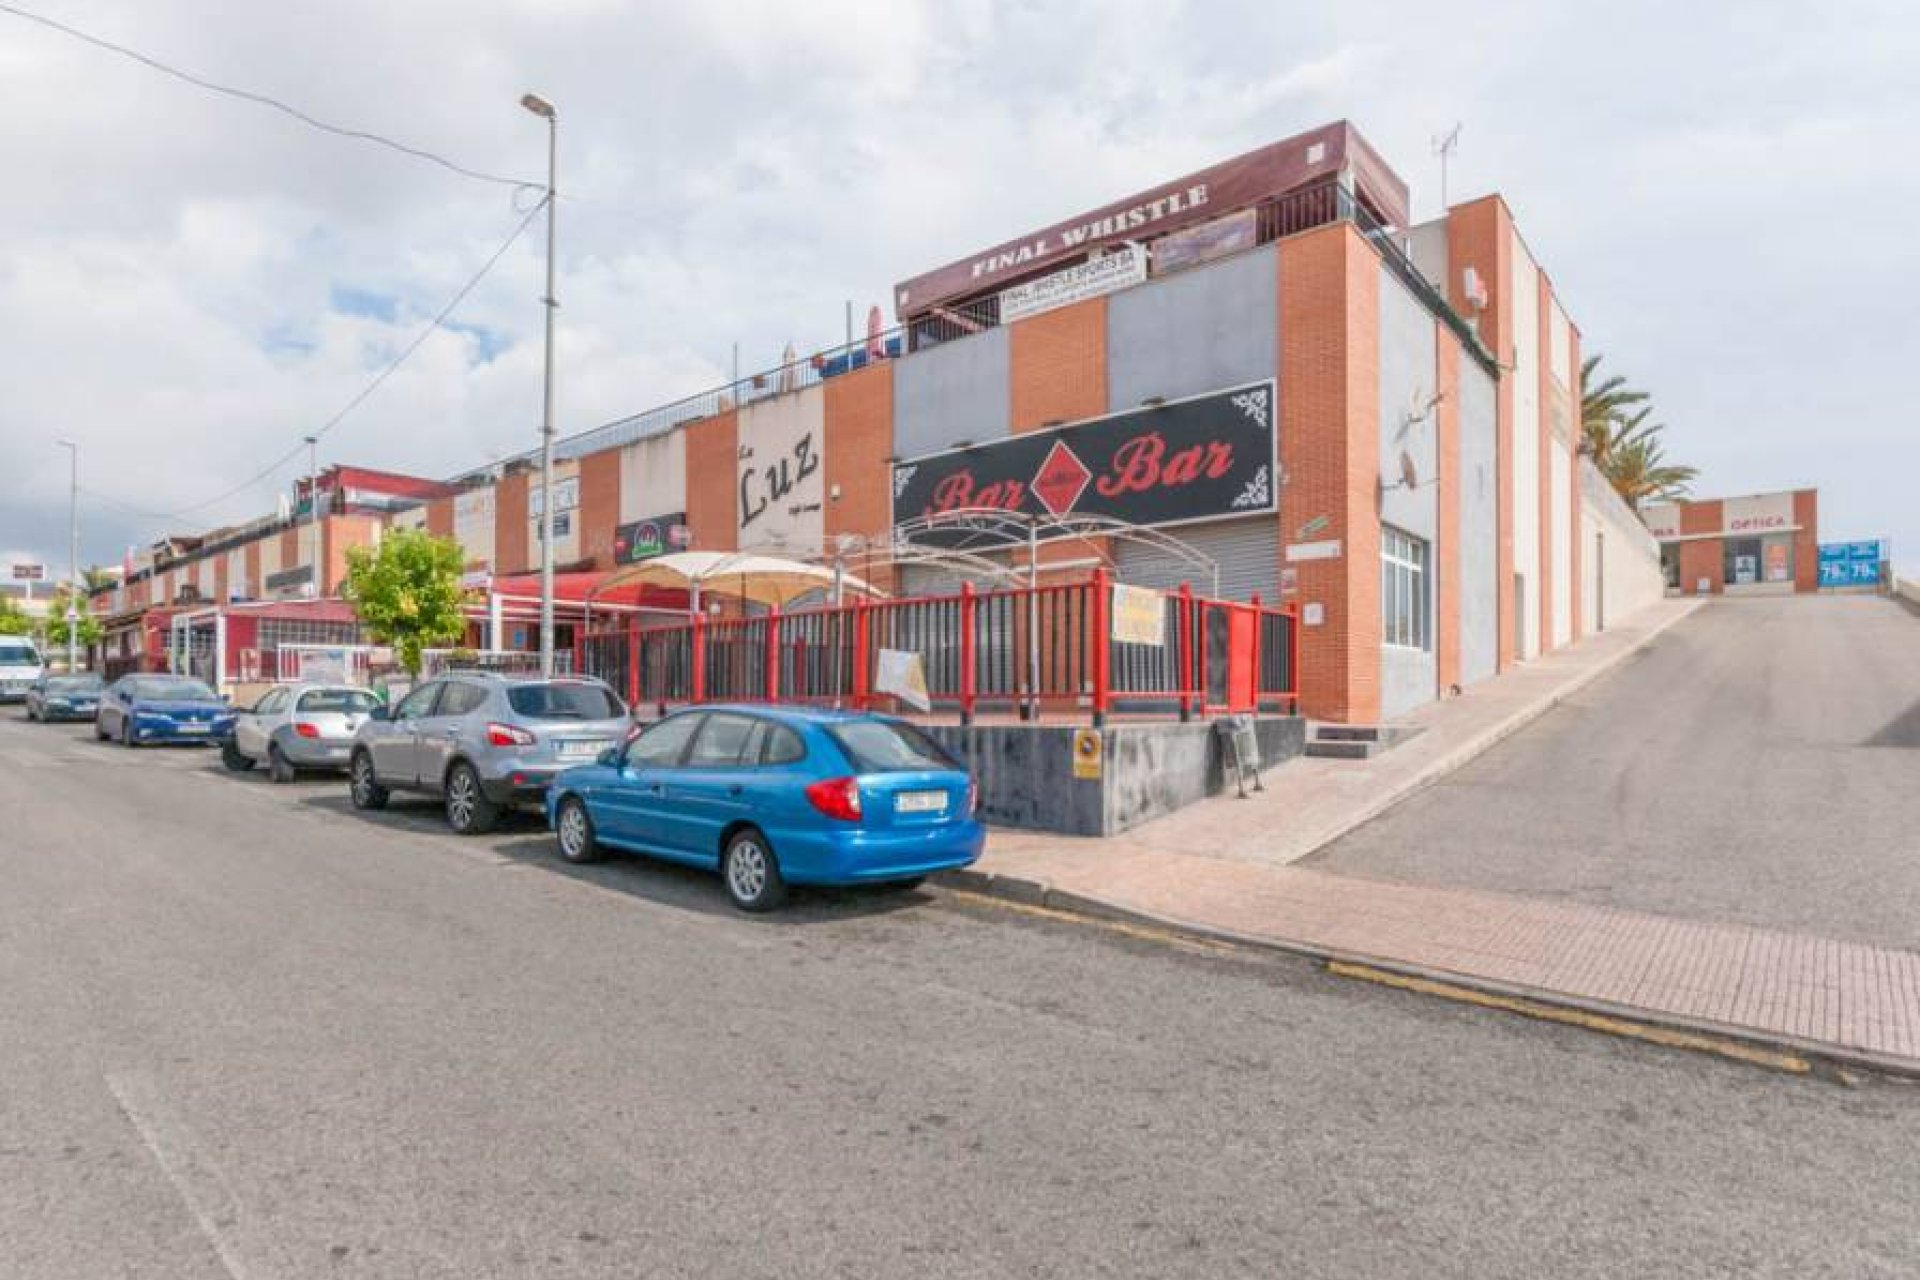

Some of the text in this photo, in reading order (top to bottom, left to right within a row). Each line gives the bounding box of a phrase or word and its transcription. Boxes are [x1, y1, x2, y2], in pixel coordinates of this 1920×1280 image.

[972, 184, 1208, 278] FINAL WHISTLE
[741, 431, 818, 529] Luz
[923, 430, 1234, 519] Bar Bar
